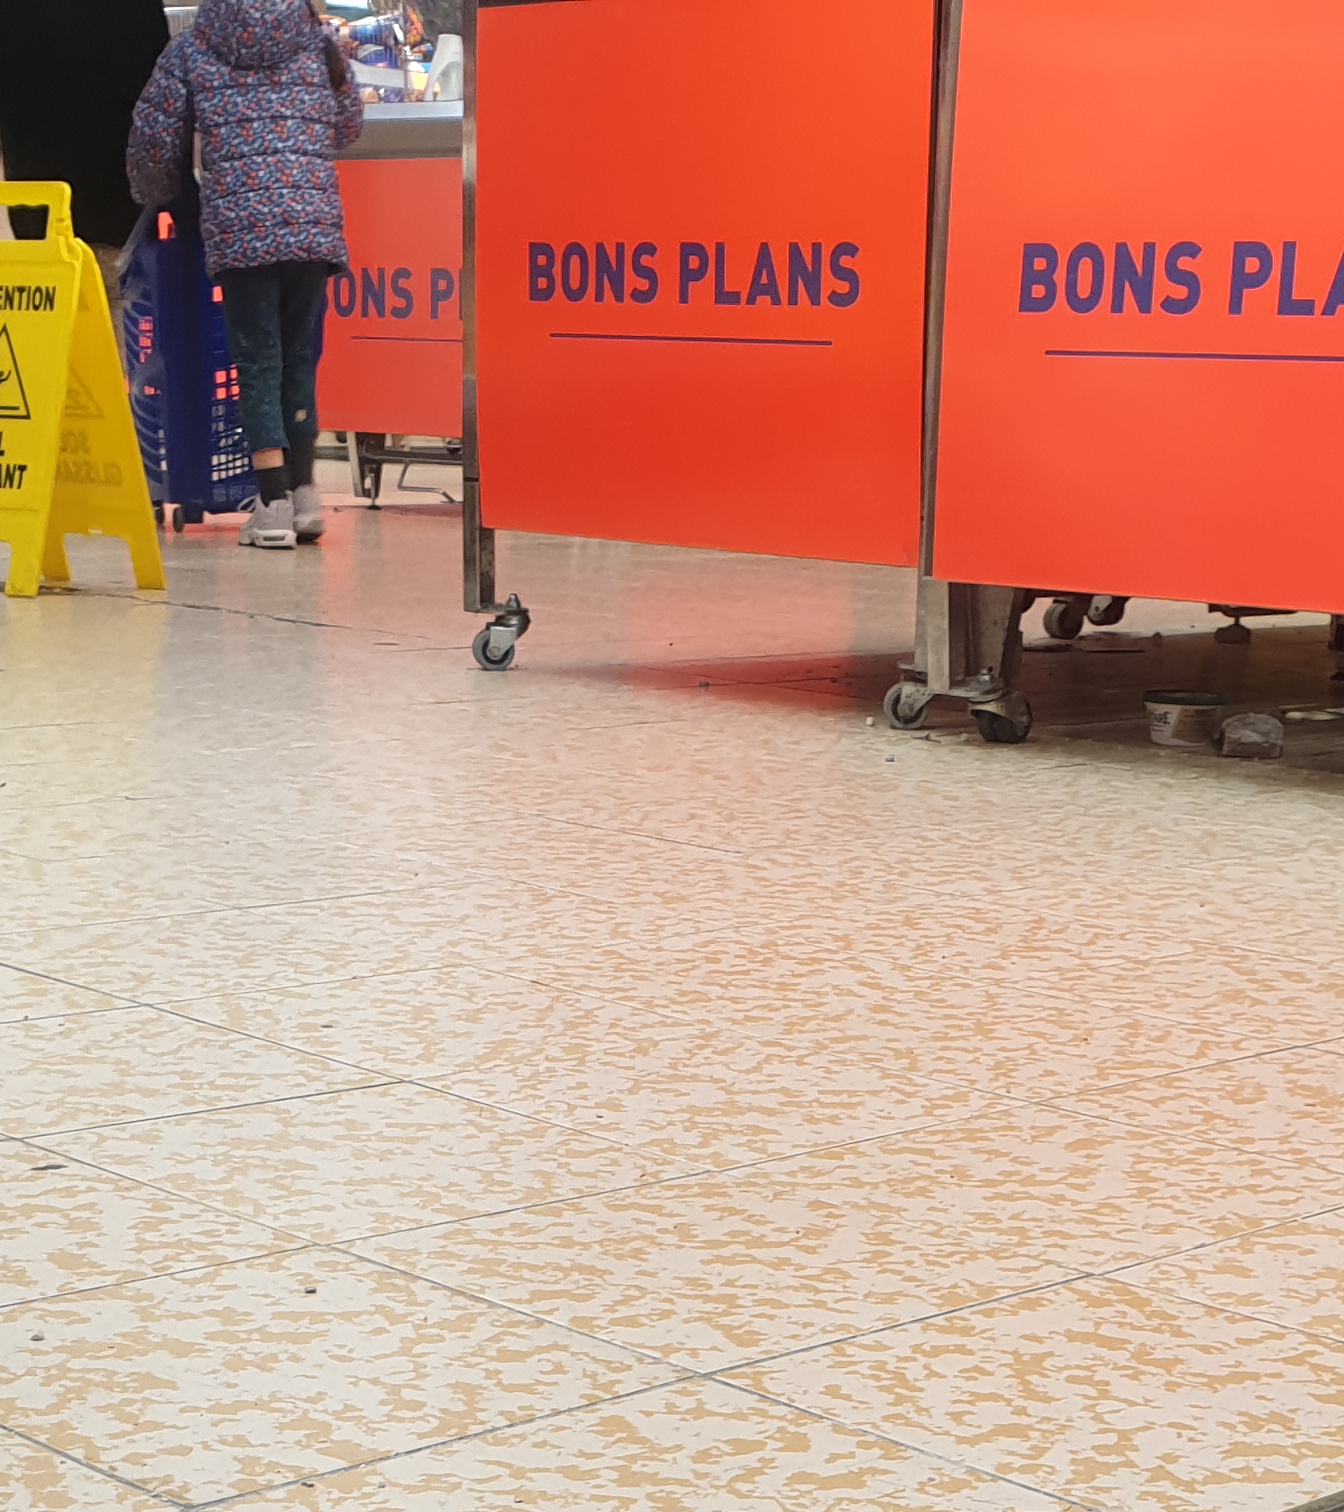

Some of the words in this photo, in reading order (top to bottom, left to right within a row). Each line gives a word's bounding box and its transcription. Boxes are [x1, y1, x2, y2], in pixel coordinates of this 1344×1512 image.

[333, 266, 414, 319] ONS
[528, 241, 659, 304] BONS
[678, 241, 861, 307] PLANS
[1018, 241, 1203, 316] BONS
